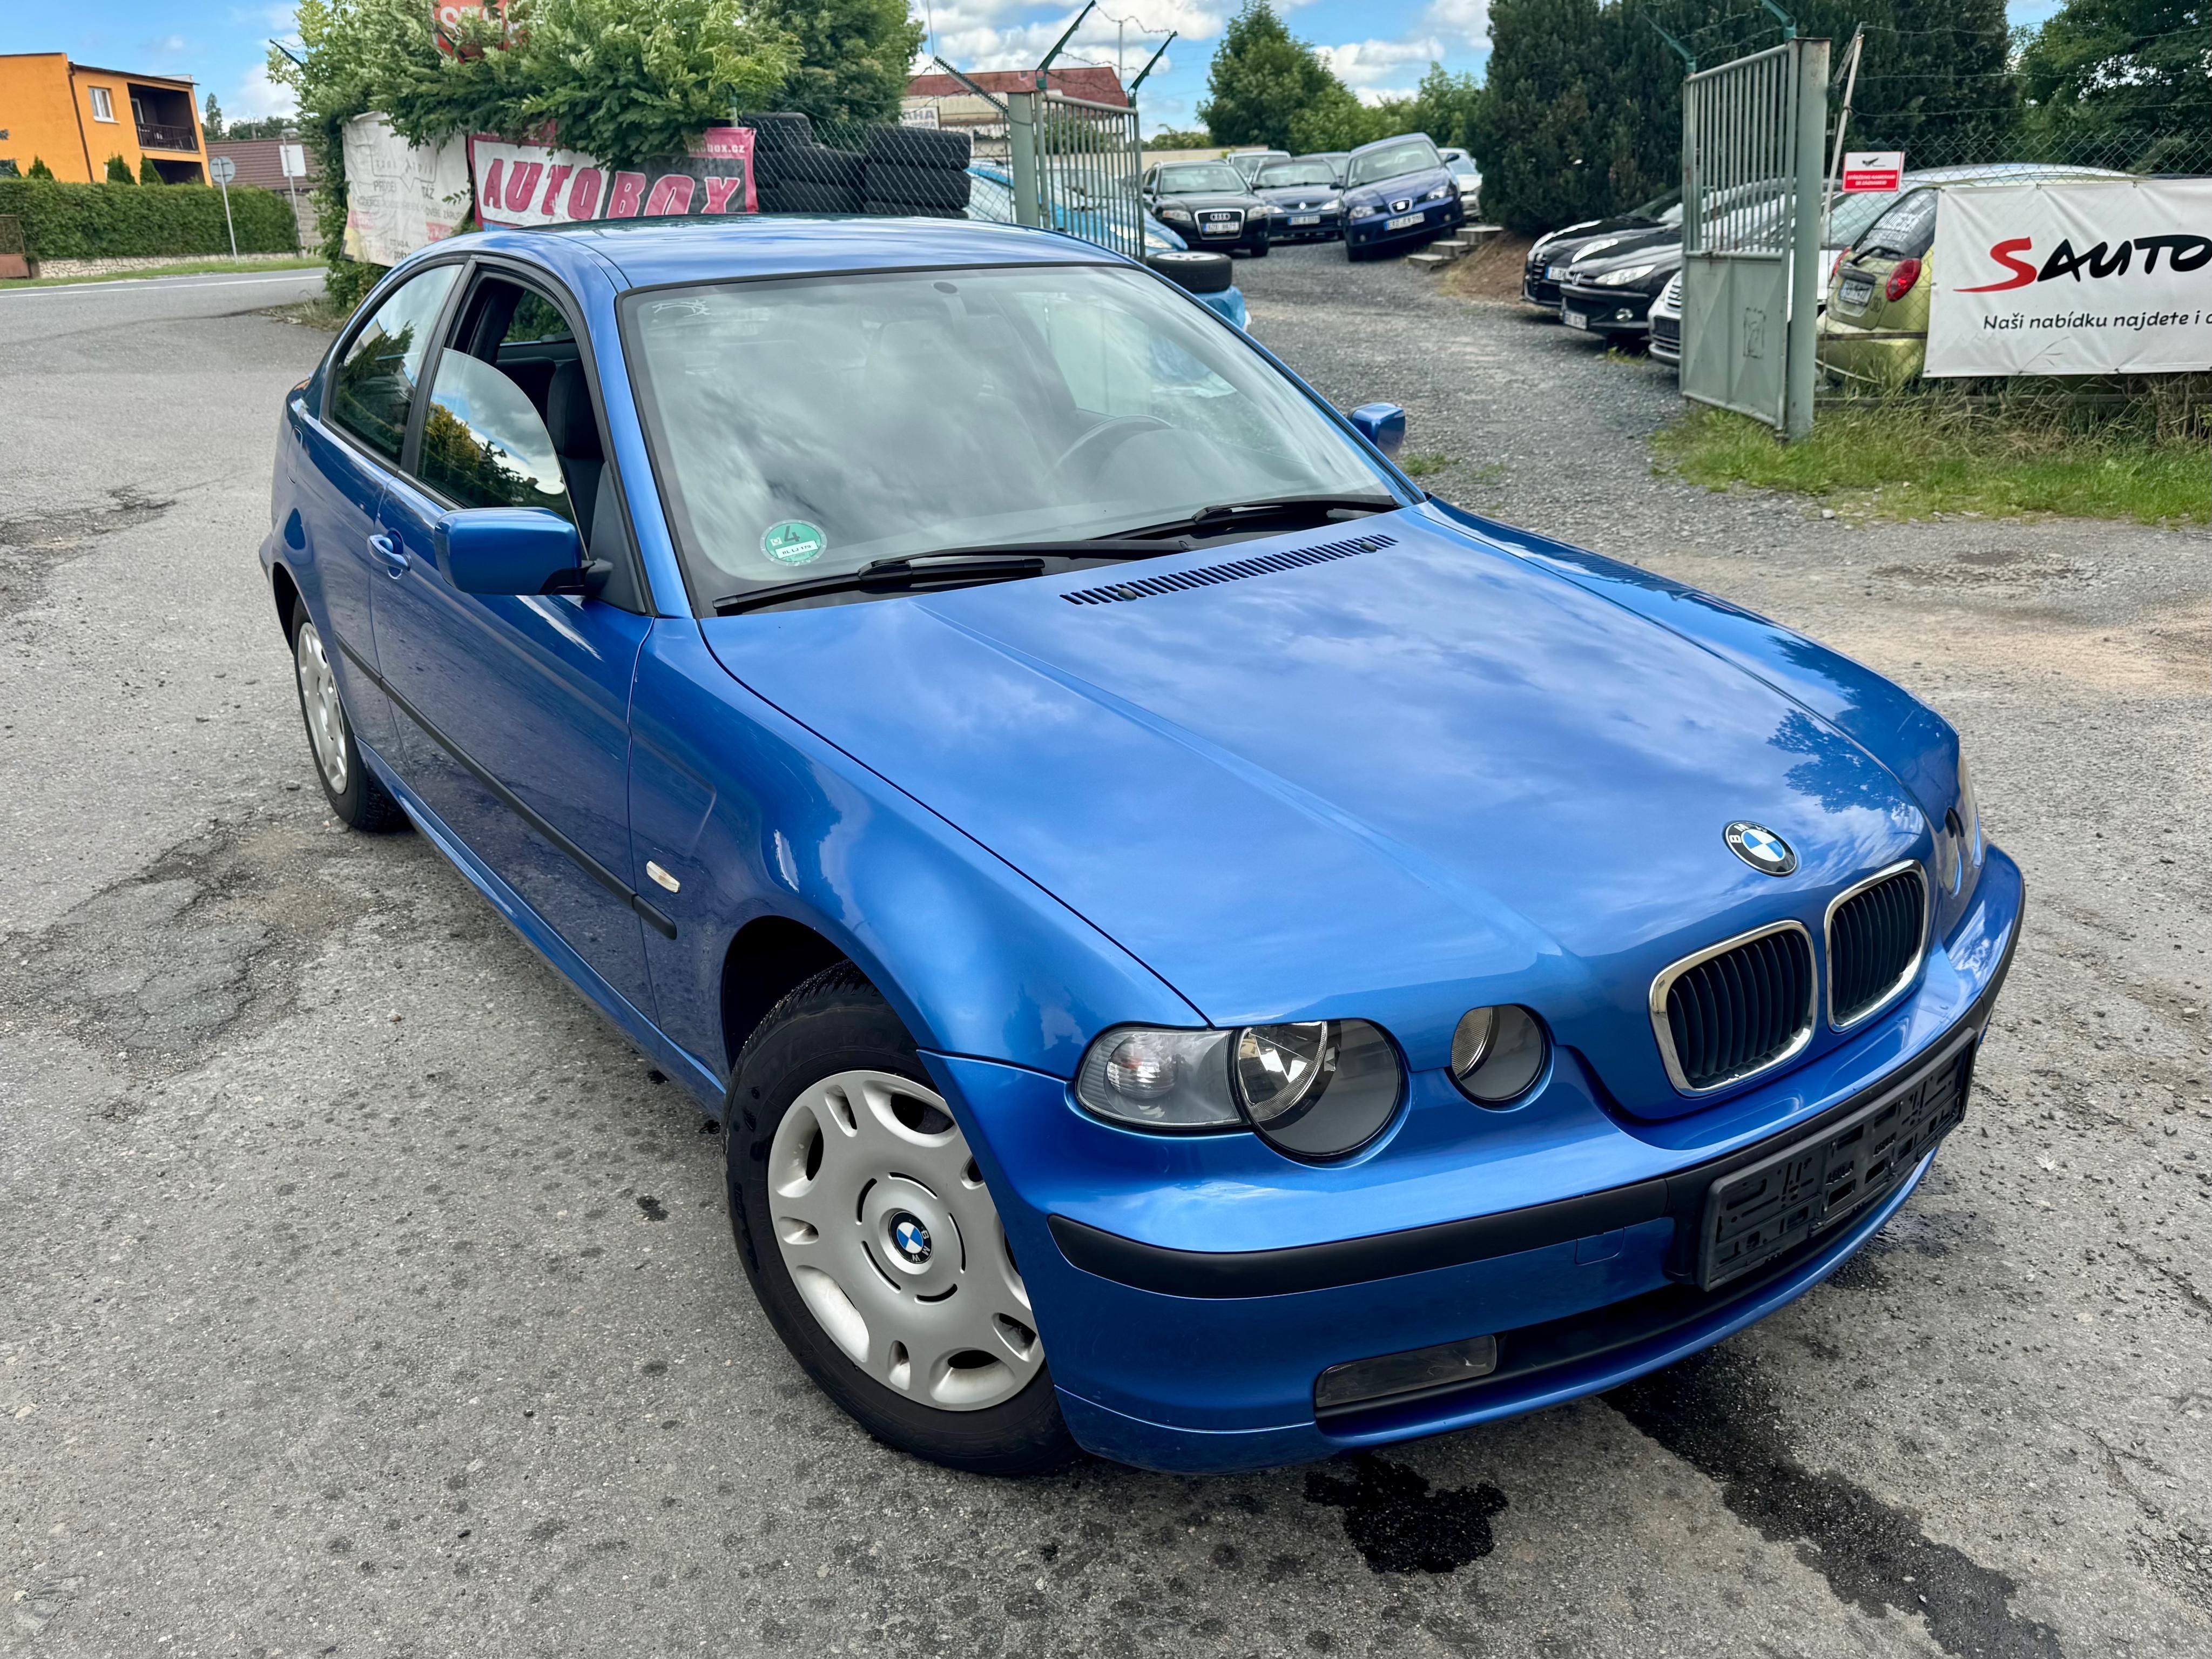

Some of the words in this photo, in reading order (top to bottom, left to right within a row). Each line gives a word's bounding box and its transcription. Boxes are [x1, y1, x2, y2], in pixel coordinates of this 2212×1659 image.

[483, 159, 740, 220] AUTOBOX
[1953, 234, 2212, 292] SAUTO
[1983, 312, 2025, 330] Naši
[2029, 311, 2107, 329] nabídku
[2113, 311, 2189, 331] najdete
[2194, 310, 2201, 325] i
[784, 525, 800, 542] 4
[1729, 824, 1768, 844] BMW
[911, 1230, 931, 1262] BMW
